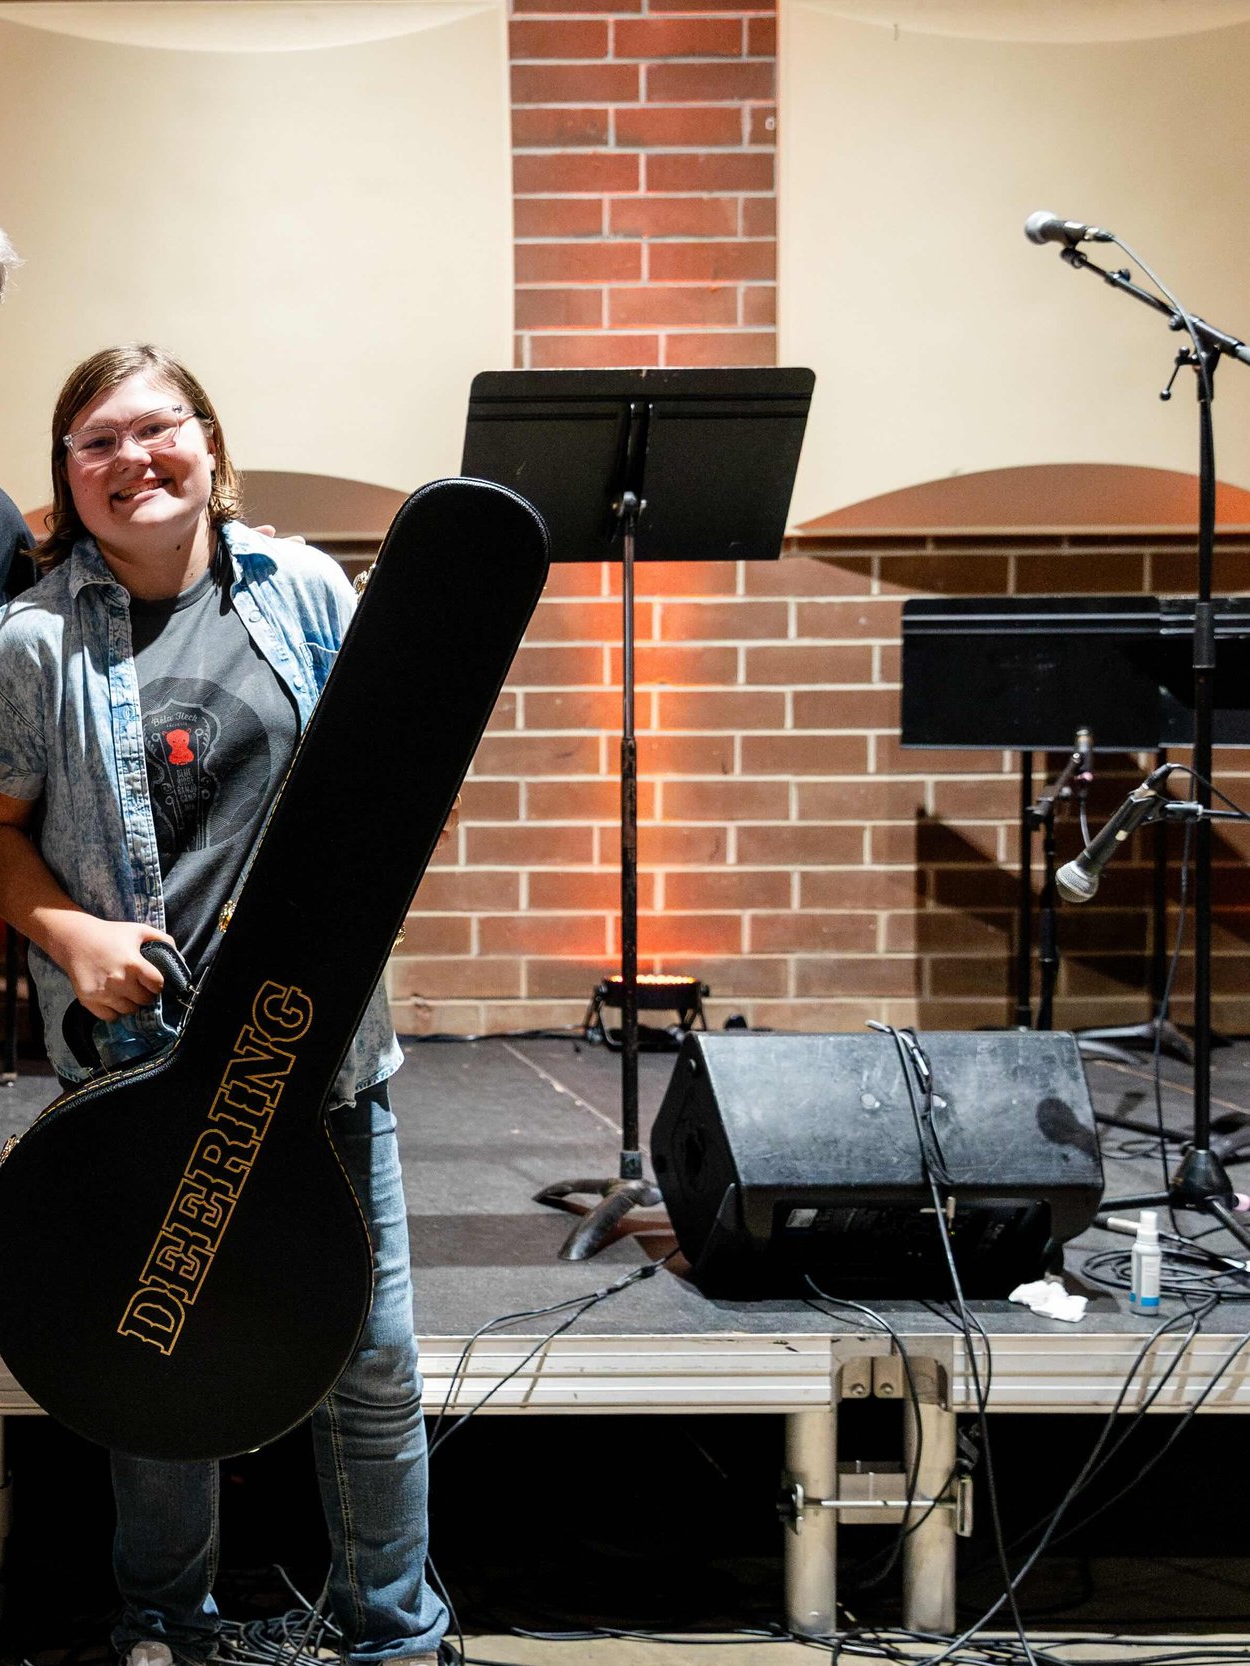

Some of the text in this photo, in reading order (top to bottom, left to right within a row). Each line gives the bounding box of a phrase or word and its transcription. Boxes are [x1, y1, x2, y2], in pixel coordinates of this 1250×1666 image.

[175, 711, 198, 723] Fleck
[177, 784, 197, 795] BANJO
[179, 792, 197, 802] CAMP
[116, 979, 314, 1357] DEERING
